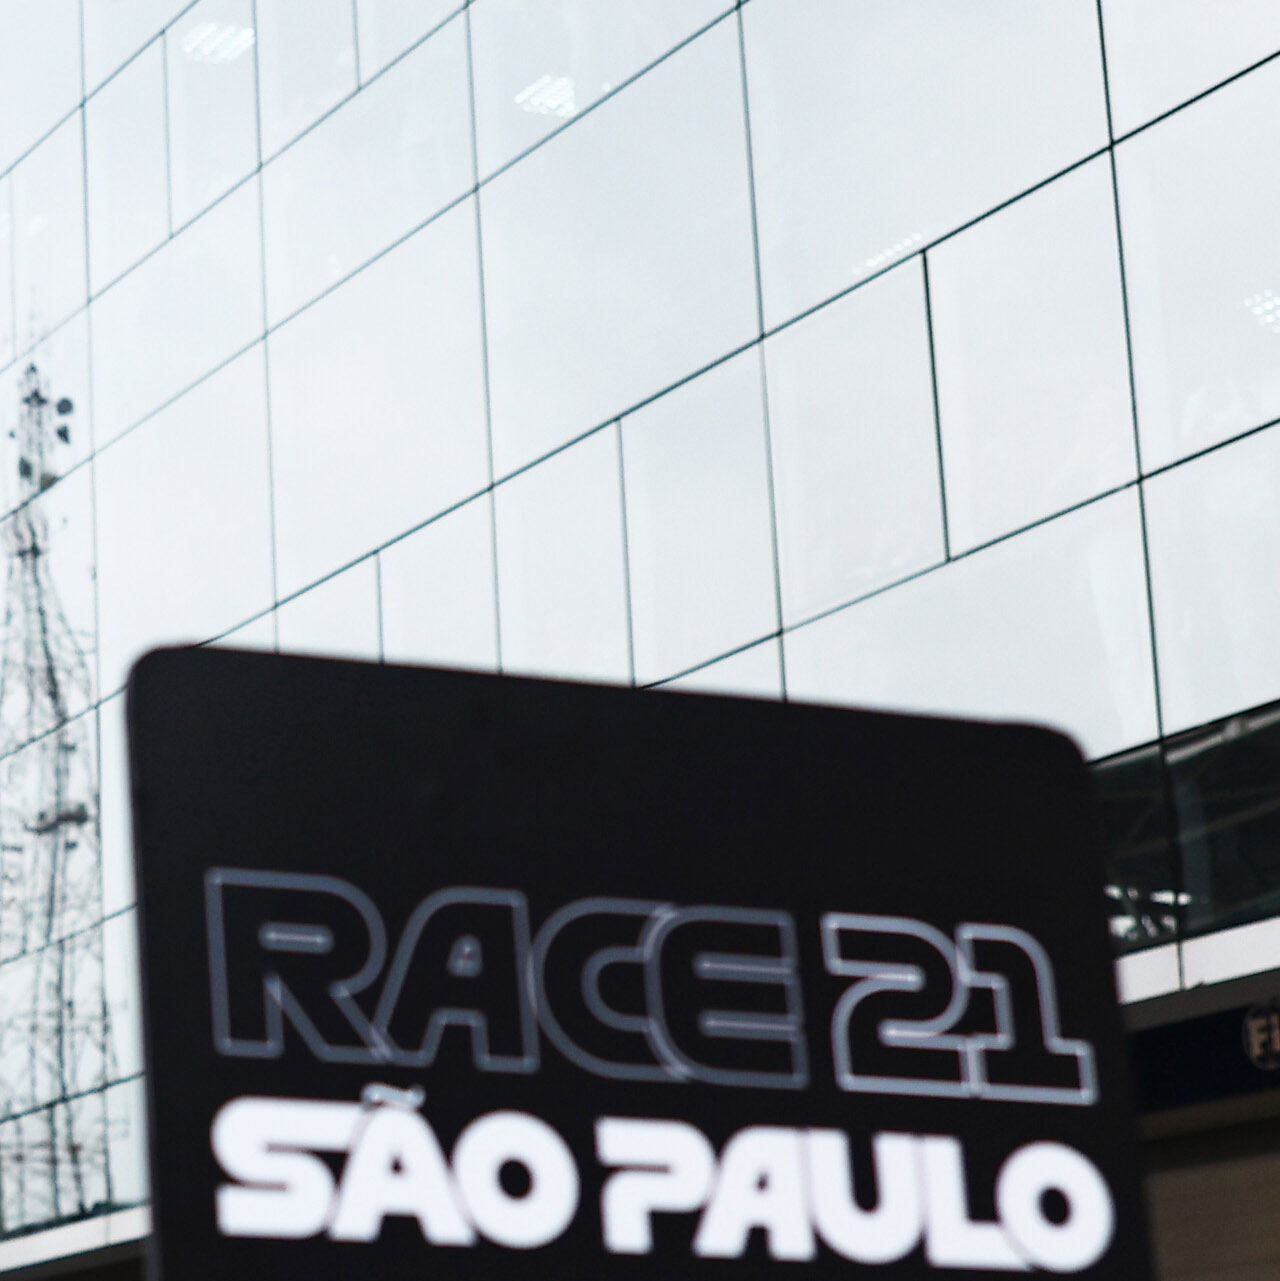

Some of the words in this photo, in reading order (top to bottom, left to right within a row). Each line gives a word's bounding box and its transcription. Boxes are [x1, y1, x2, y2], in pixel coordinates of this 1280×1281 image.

[203, 866, 810, 1089] RACE
[821, 911, 1099, 1105] 21
[210, 1082, 580, 1250] SÃO
[594, 1116, 1116, 1274] PAULO
